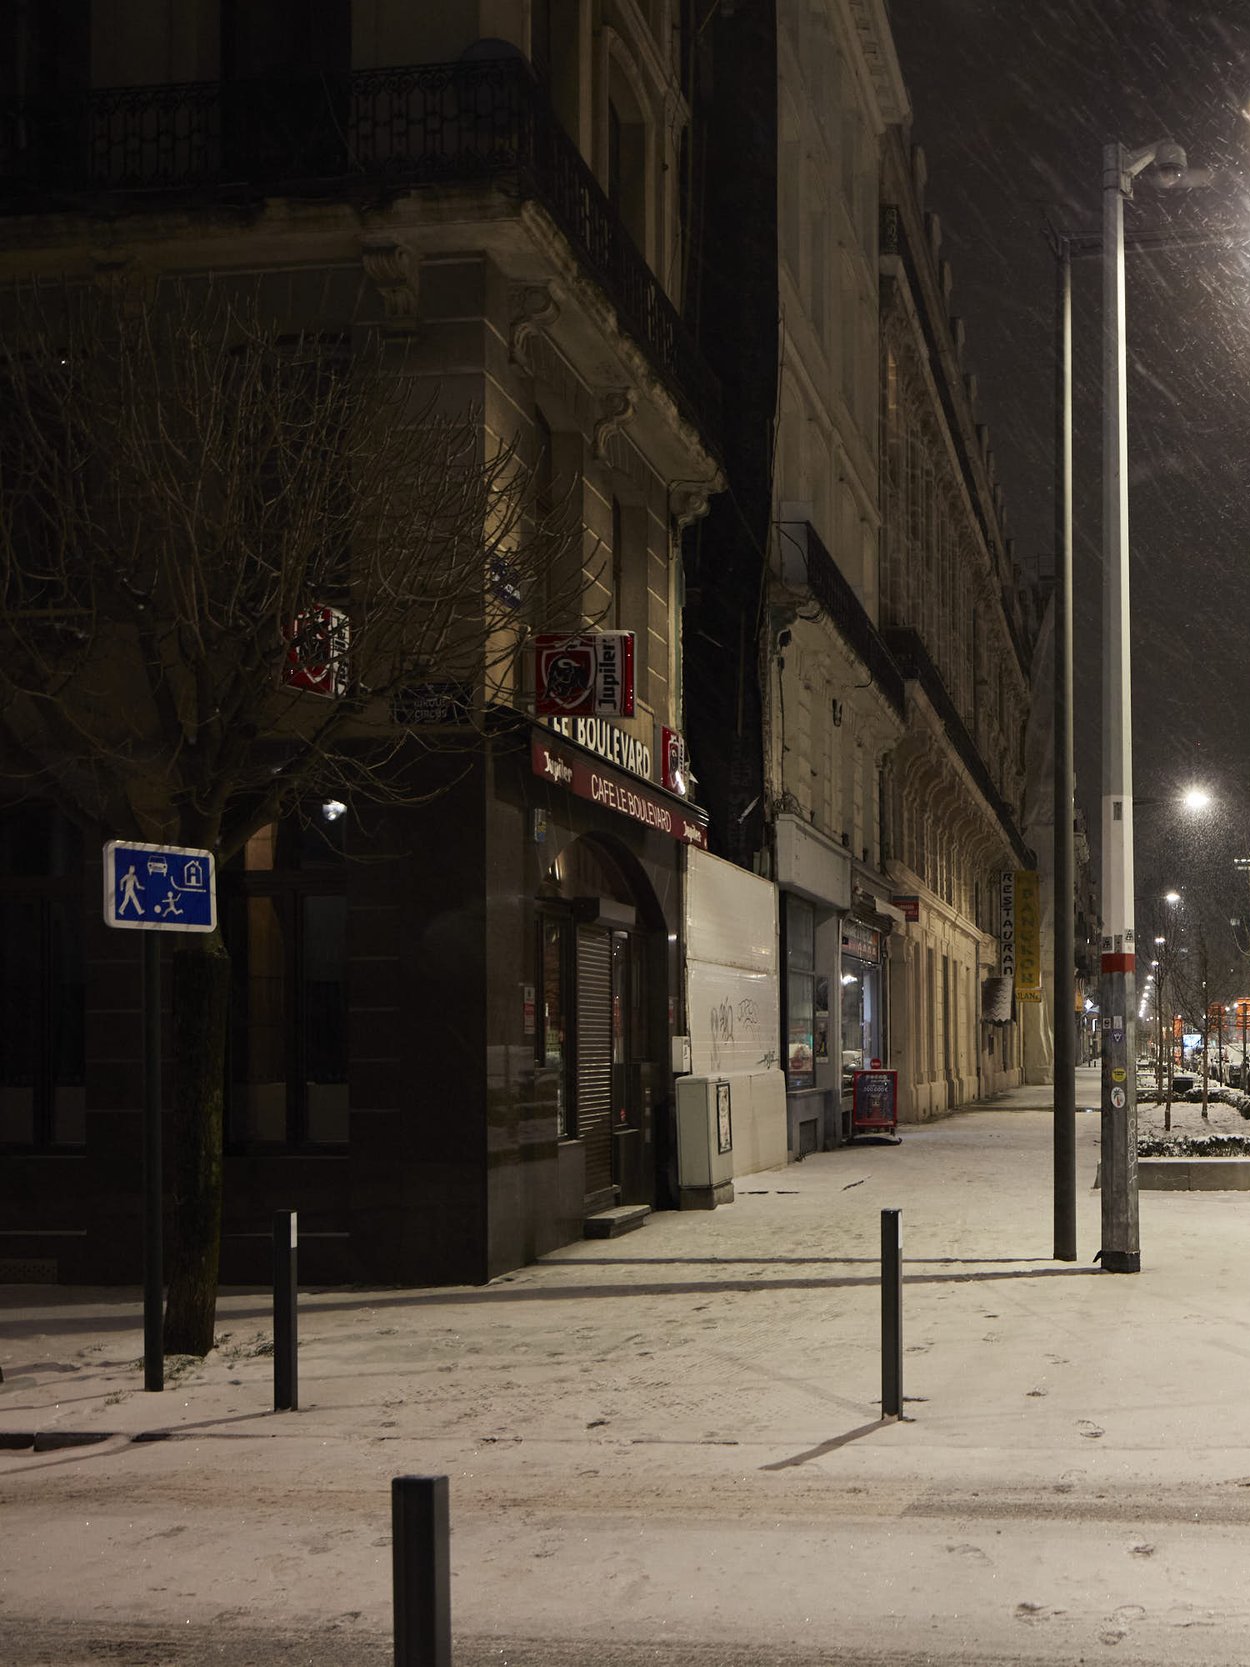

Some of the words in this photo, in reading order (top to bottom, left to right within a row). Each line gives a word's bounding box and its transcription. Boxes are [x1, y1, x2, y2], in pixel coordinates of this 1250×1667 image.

[600, 639, 620, 709] Jupiler
[544, 751, 573, 782] Jupiler
[554, 717, 569, 737] LE
[577, 718, 651, 779] BOULEVARD
[591, 774, 616, 808] CAFE
[616, 786, 628, 813] LE
[628, 792, 672, 832] BOULEVARD
[1003, 873, 1013, 976] RESTAURAN
